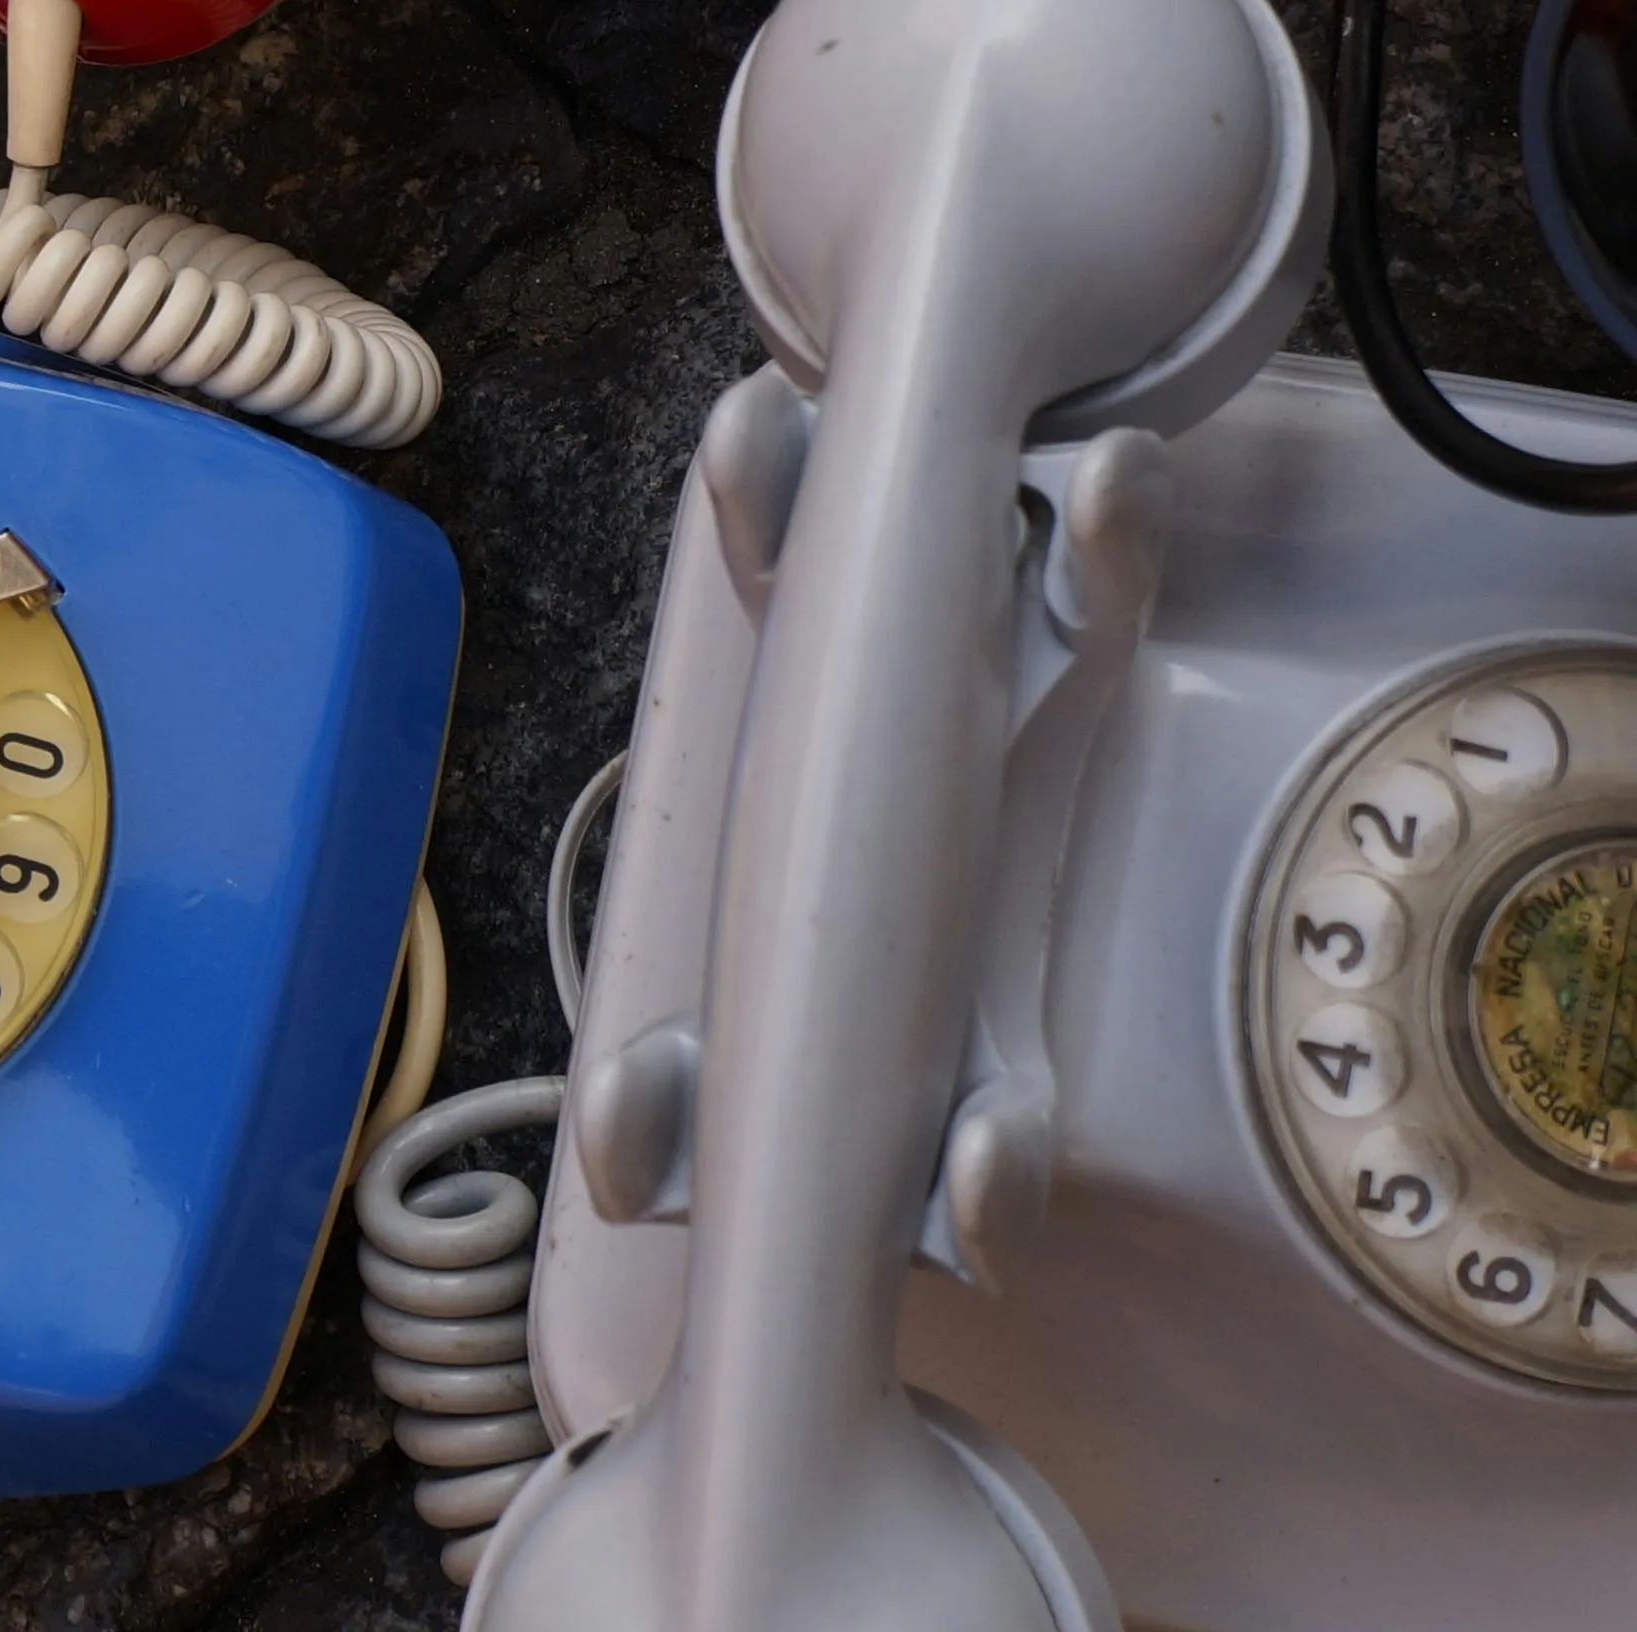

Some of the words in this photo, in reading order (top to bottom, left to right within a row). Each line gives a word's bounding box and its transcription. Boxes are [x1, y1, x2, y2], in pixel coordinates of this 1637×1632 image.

[1449, 737, 1508, 762] 1
[1349, 802, 1417, 860] 2
[1294, 913, 1365, 974] 3
[1496, 868, 1597, 998] NACIONAL
[1297, 1039, 1372, 1099] 4
[1499, 1023, 1610, 1146] EMPRESA
[1355, 1169, 1433, 1226] 5
[1455, 1249, 1532, 1304] 6
[1578, 1277, 1637, 1334] 7
